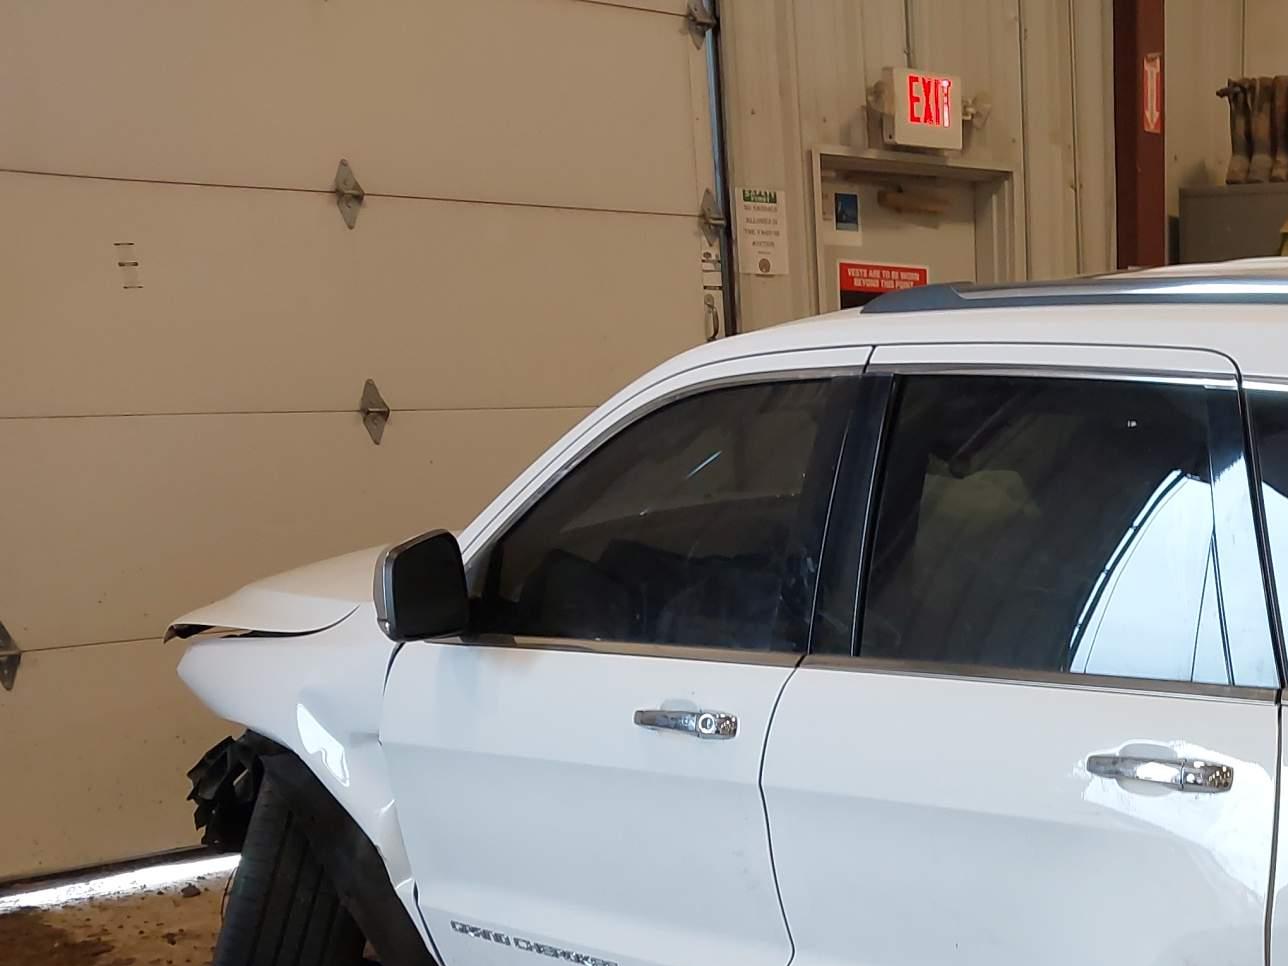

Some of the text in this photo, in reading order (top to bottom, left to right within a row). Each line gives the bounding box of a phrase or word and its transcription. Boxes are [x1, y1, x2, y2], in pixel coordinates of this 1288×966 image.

[908, 73, 952, 128] EXIT
[847, 268, 867, 278] VESTS
[868, 269, 880, 279] ARE
[881, 270, 890, 279] TO
[853, 278, 879, 288] BEYOND
[881, 279, 894, 289] THIS
[450, 919, 512, 947] GRAND
